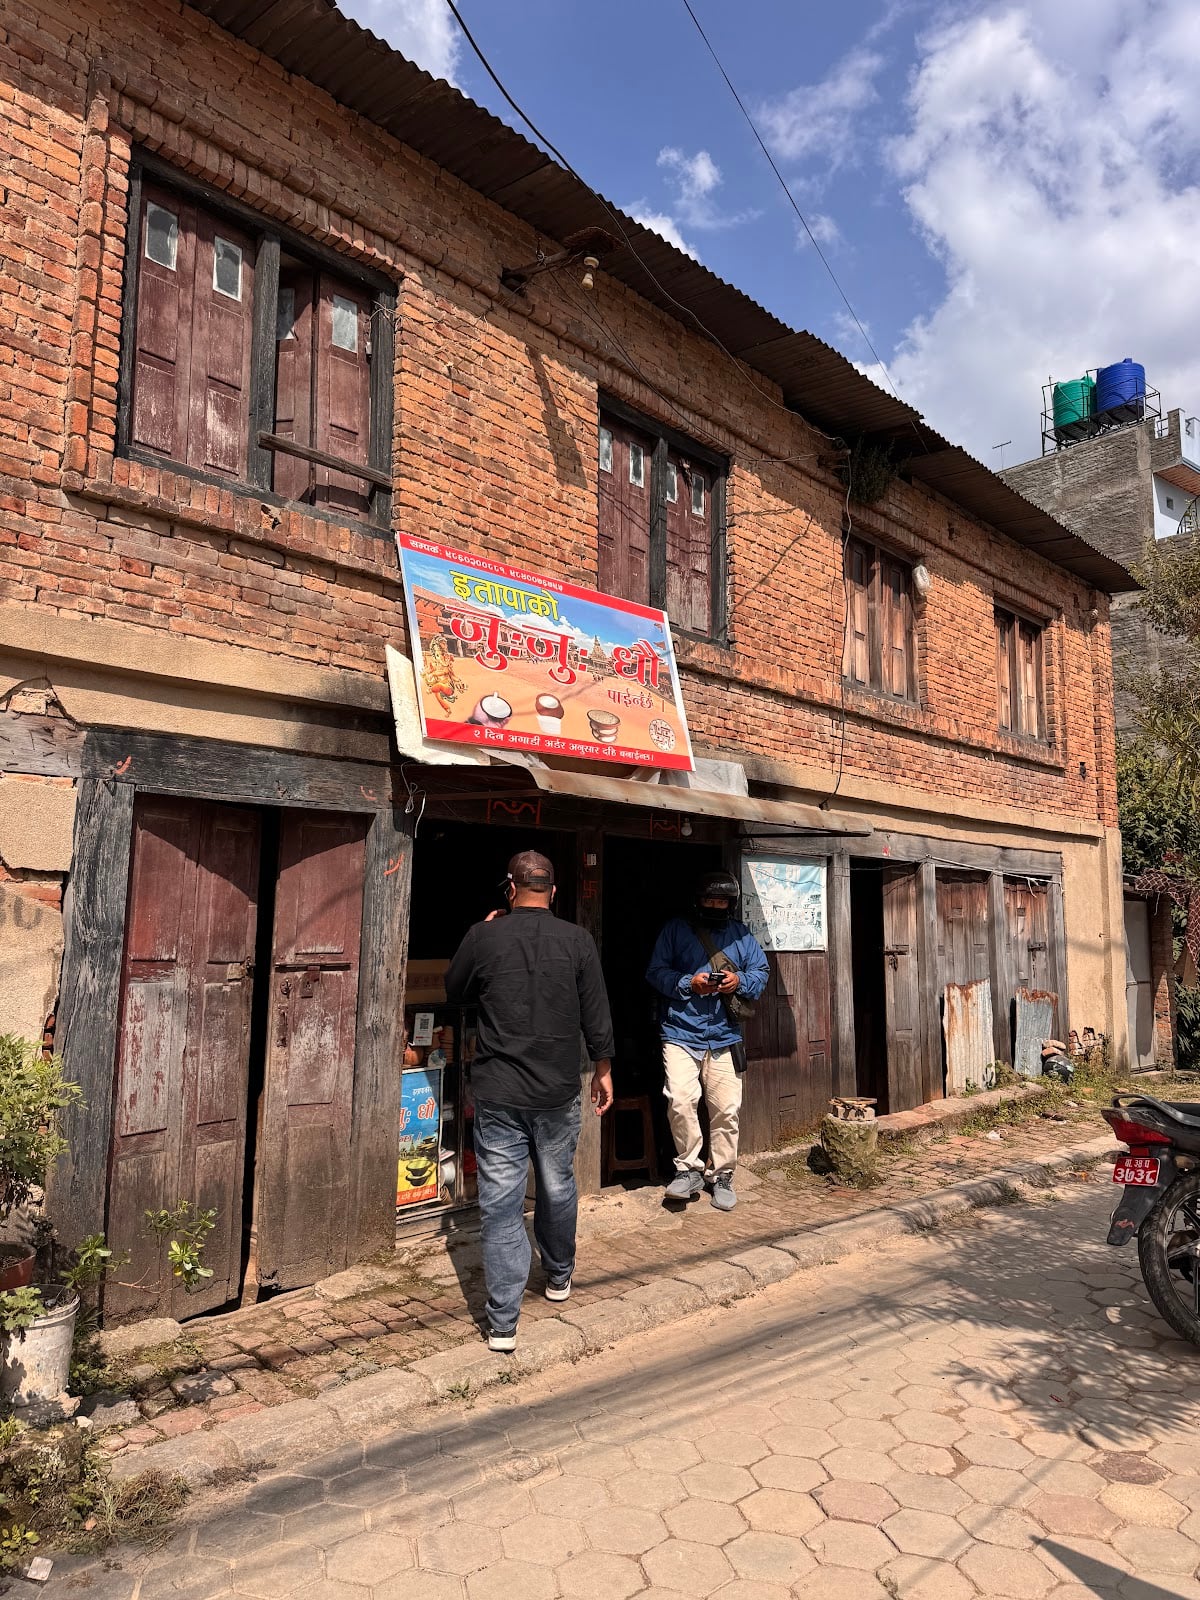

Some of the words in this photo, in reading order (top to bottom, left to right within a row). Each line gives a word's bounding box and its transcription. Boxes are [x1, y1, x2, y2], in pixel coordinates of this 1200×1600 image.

[449, 570, 560, 621] इतापाको
[611, 638, 664, 689] धौ
[473, 729, 481, 738] २
[484, 728, 504, 741] दिन
[508, 734, 540, 746] अगाडी
[544, 738, 566, 749] अर्डर
[568, 742, 600, 755] अनुसार
[602, 745, 617, 757] दहि
[1115, 1168, 1157, 1184] ३७३८
